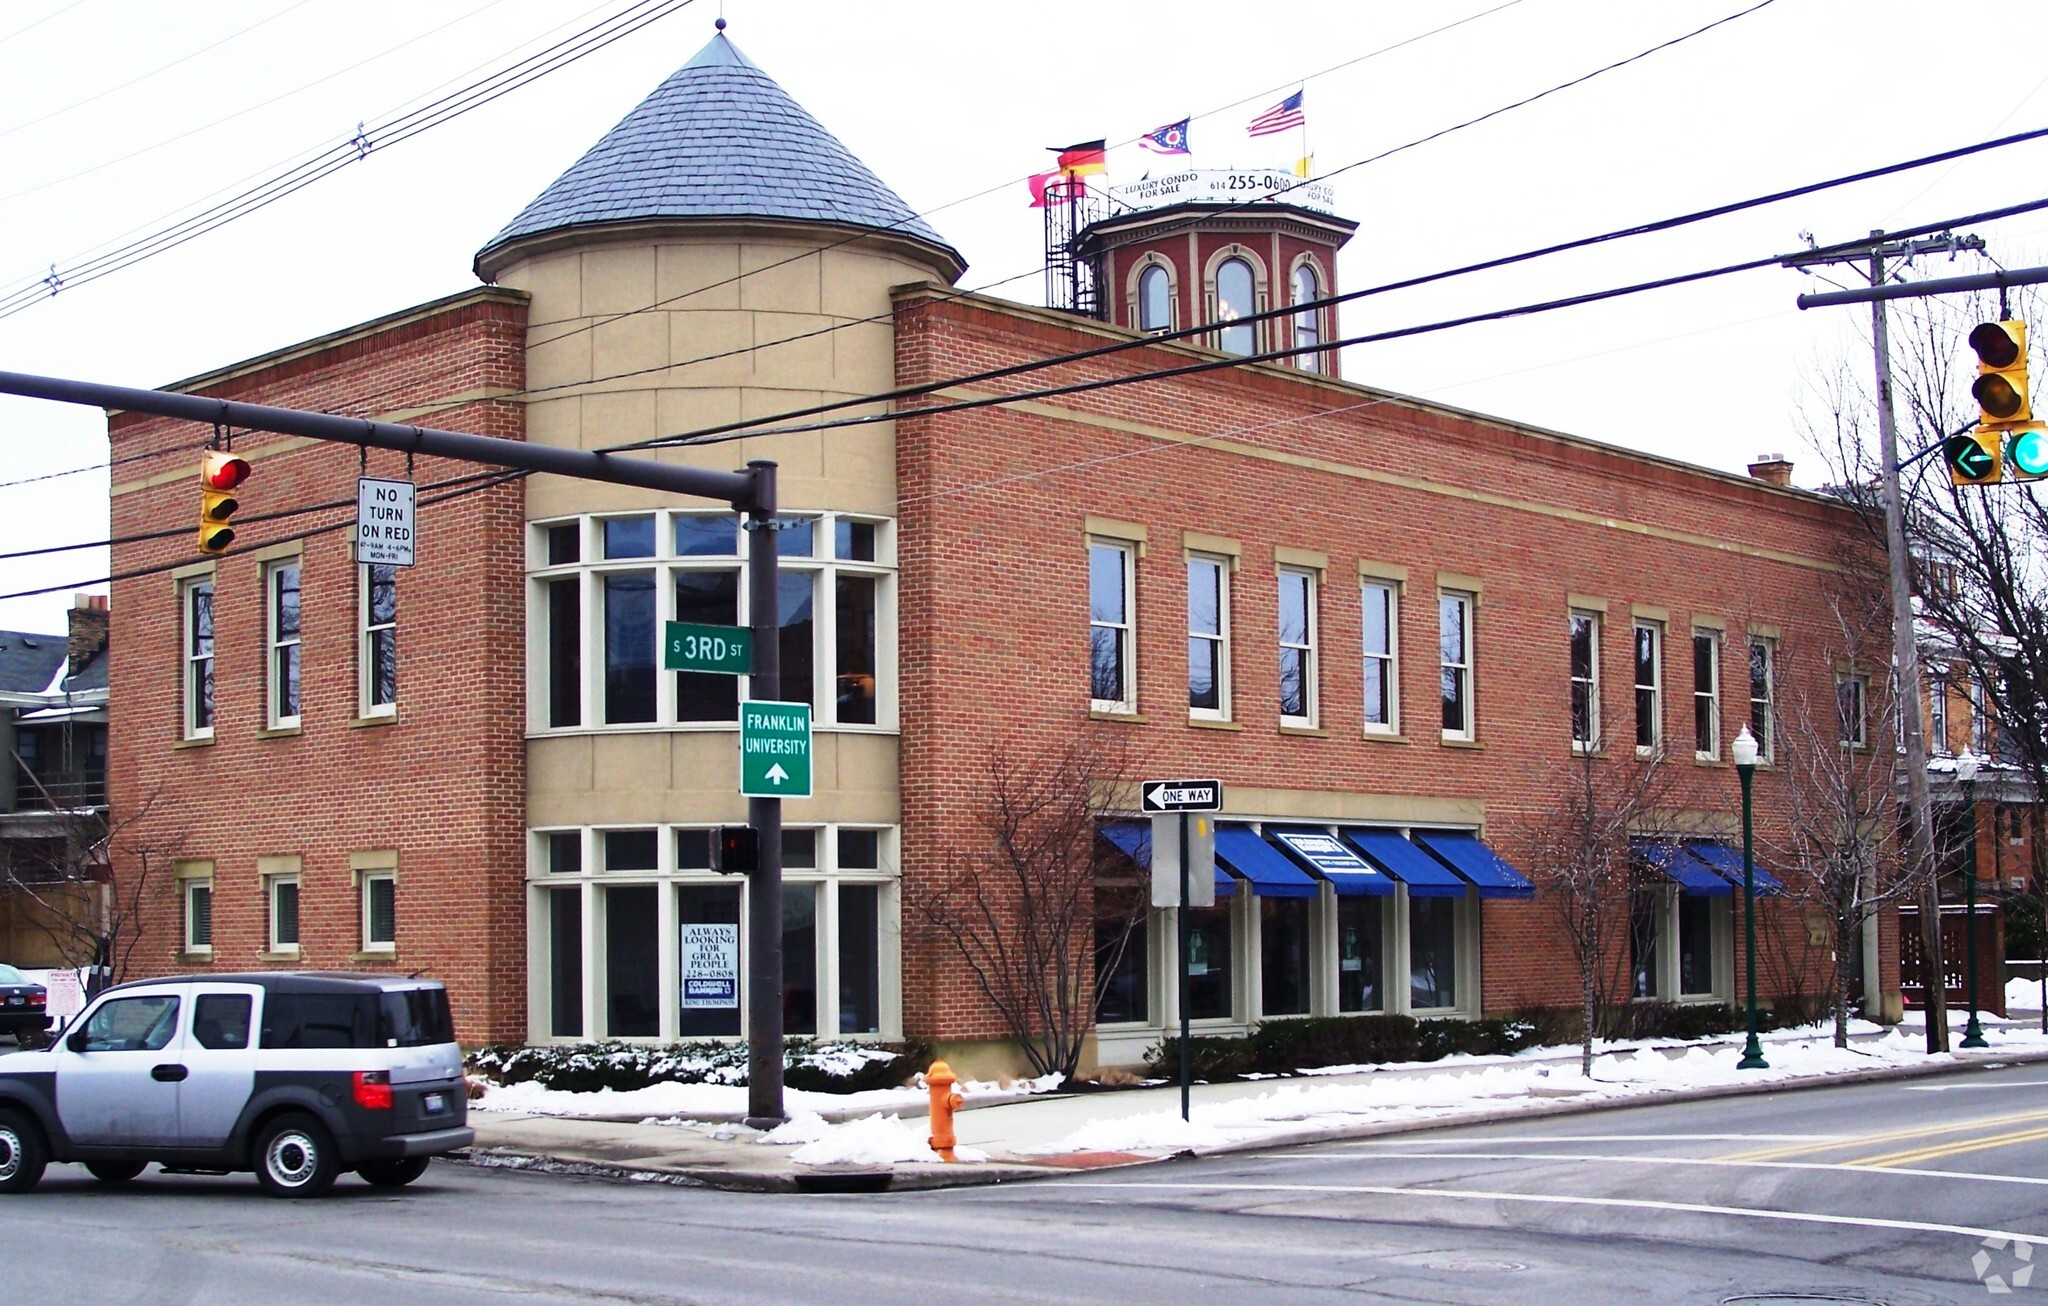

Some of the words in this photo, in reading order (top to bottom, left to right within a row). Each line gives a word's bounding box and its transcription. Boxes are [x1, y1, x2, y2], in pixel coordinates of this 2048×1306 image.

[1125, 180, 1159, 194] LUXURY
[1161, 173, 1198, 186] CONDO
[1210, 181, 1226, 190] 614
[1228, 175, 1291, 192] 255-0600
[1140, 188, 1158, 199] FOR
[1160, 184, 1181, 195] SALE
[376, 488, 398, 502] NO
[370, 506, 403, 521] TURN
[362, 524, 380, 538] ON
[385, 526, 410, 541] RED
[370, 552, 399, 560] MON-FRI
[673, 640, 680, 653] S
[684, 636, 726, 660] 3RD
[730, 644, 743, 656] ST
[747, 714, 805, 732] FRANKLIN
[745, 737, 807, 755] UNIVERSITY
[1162, 790, 1183, 802] ONE
[1188, 790, 1211, 801] WAY
[689, 928, 731, 936] ALWAYS
[685, 936, 735, 944] LOOKING
[700, 944, 720, 952] FOR
[692, 952, 727, 960] GREAT
[690, 960, 730, 968] PEOPLE
[686, 970, 734, 978] 228-0808
